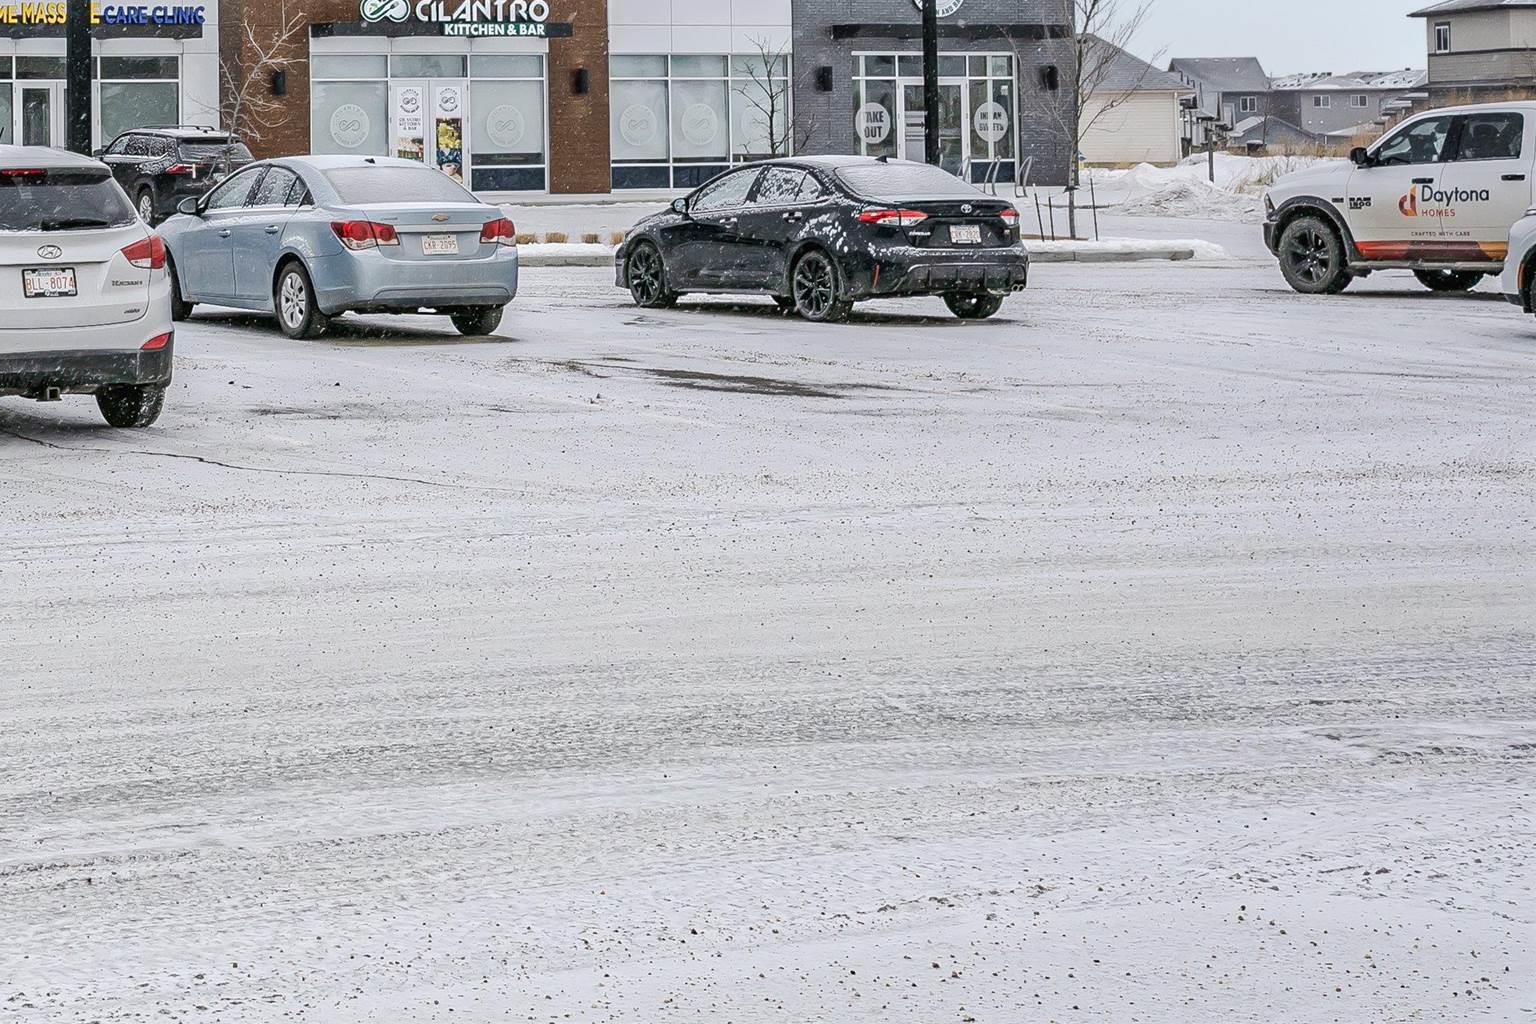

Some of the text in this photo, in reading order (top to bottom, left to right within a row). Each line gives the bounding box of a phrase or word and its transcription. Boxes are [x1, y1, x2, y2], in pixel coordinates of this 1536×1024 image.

[21, 2, 100, 24] MASSE
[103, 5, 147, 24] CARE
[152, 5, 206, 24] CLINIC
[444, 23, 546, 36] KITTCHEN & BAR
[864, 126, 883, 139] OUT
[1421, 184, 1490, 207] Daytona
[1421, 209, 1456, 218] HOMES
